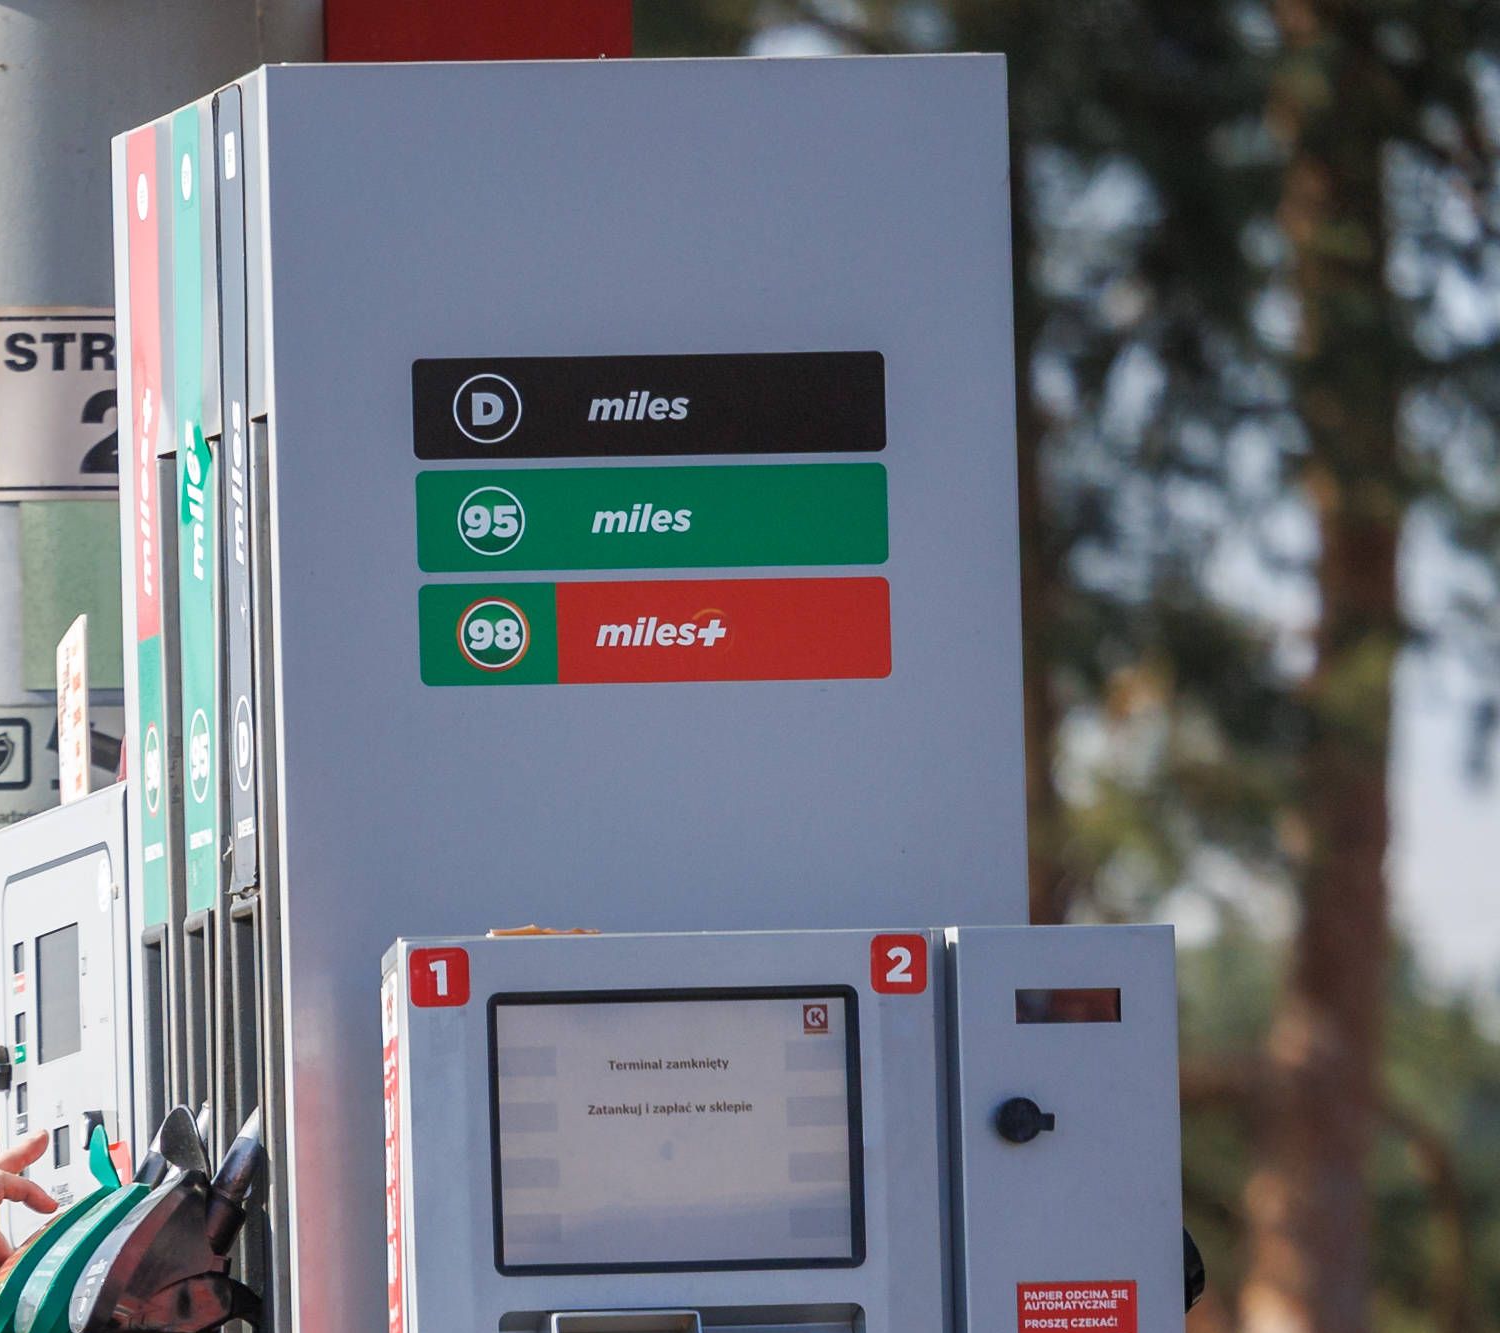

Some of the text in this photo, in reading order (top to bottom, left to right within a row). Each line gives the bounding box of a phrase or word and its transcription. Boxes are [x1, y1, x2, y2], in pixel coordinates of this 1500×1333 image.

[4, 332, 116, 372] STR
[471, 391, 690, 426] D miles
[185, 419, 204, 580] miles
[231, 400, 244, 565] miles
[464, 504, 692, 539] 95 miles
[468, 617, 726, 651] 98 miles+
[192, 733, 209, 781] 95
[239, 721, 249, 768] D
[429, 960, 448, 996] 1
[886, 946, 912, 983] 2
[608, 1058, 729, 1071] Terminal zamknięty
[588, 1103, 642, 1116] Zatankuj
[646, 1103, 649, 1113] i
[653, 1102, 691, 1116] zapłać
[710, 1101, 752, 1114] sklepie
[1024, 1289, 1128, 1300] PAPIER ODCINA SIĘ
[1025, 1300, 1117, 1310] AUTOMATYCZNIE
[1025, 1315, 1118, 1329] PROSZĘ CZEKAĆ!
